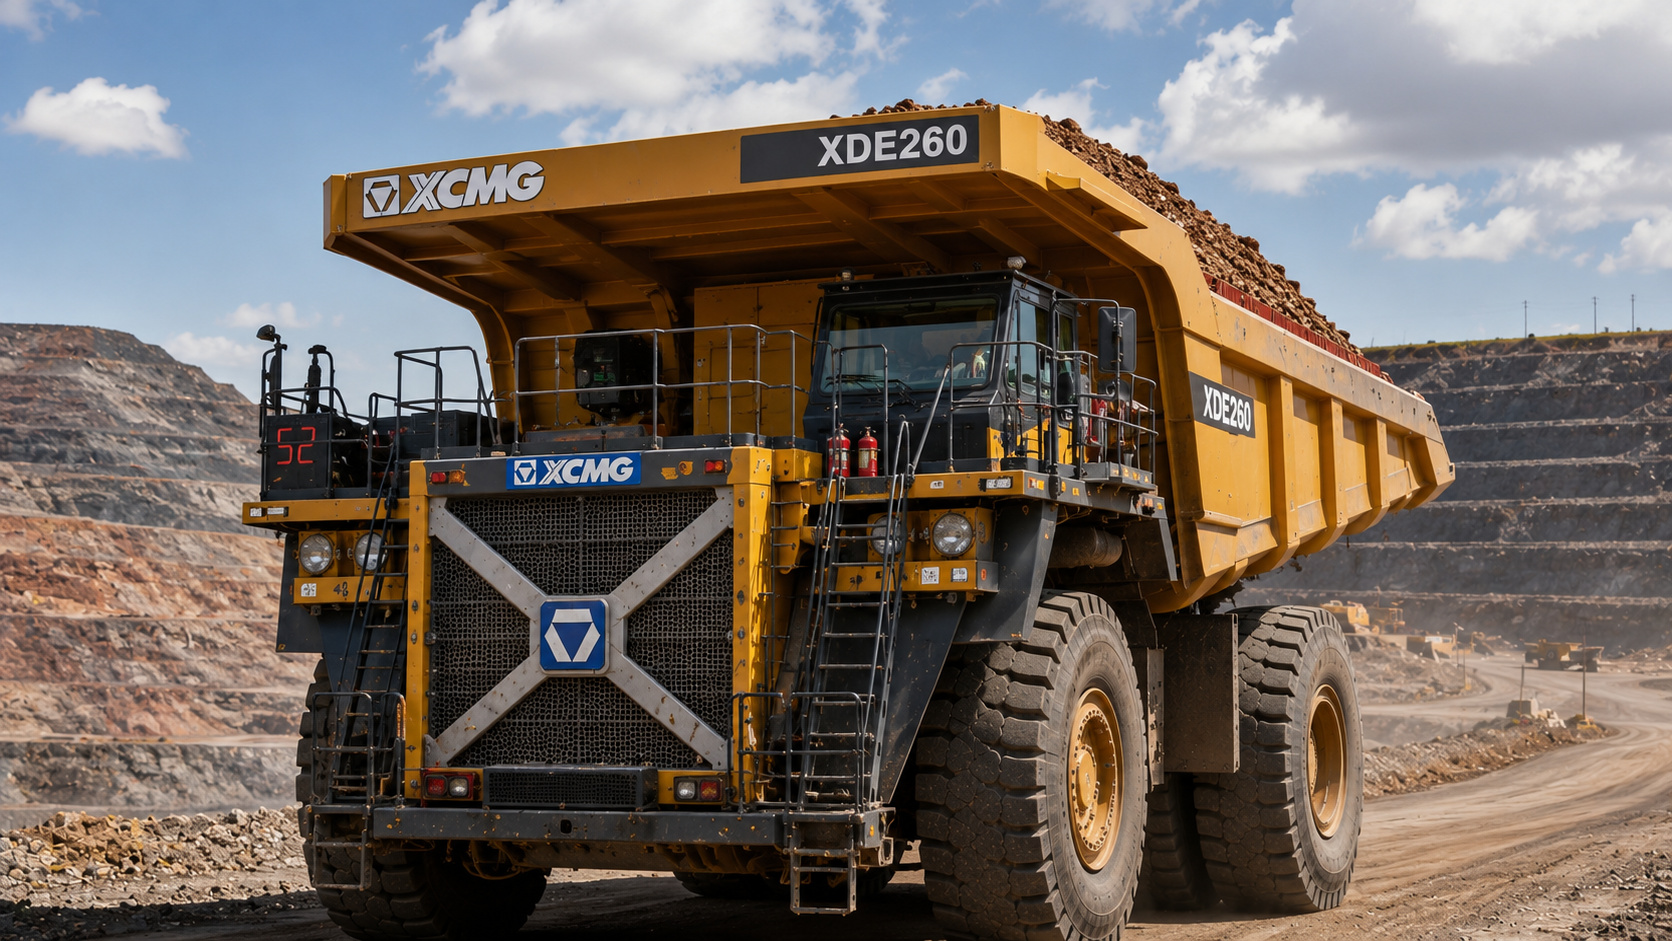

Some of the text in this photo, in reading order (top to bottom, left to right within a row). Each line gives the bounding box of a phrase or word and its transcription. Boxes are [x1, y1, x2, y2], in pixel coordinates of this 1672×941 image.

[817, 124, 968, 167] XDE260
[401, 160, 545, 215] XCMG
[1203, 384, 1251, 432] XDE260
[277, 426, 316, 466] 52
[538, 456, 634, 486] XCMG
